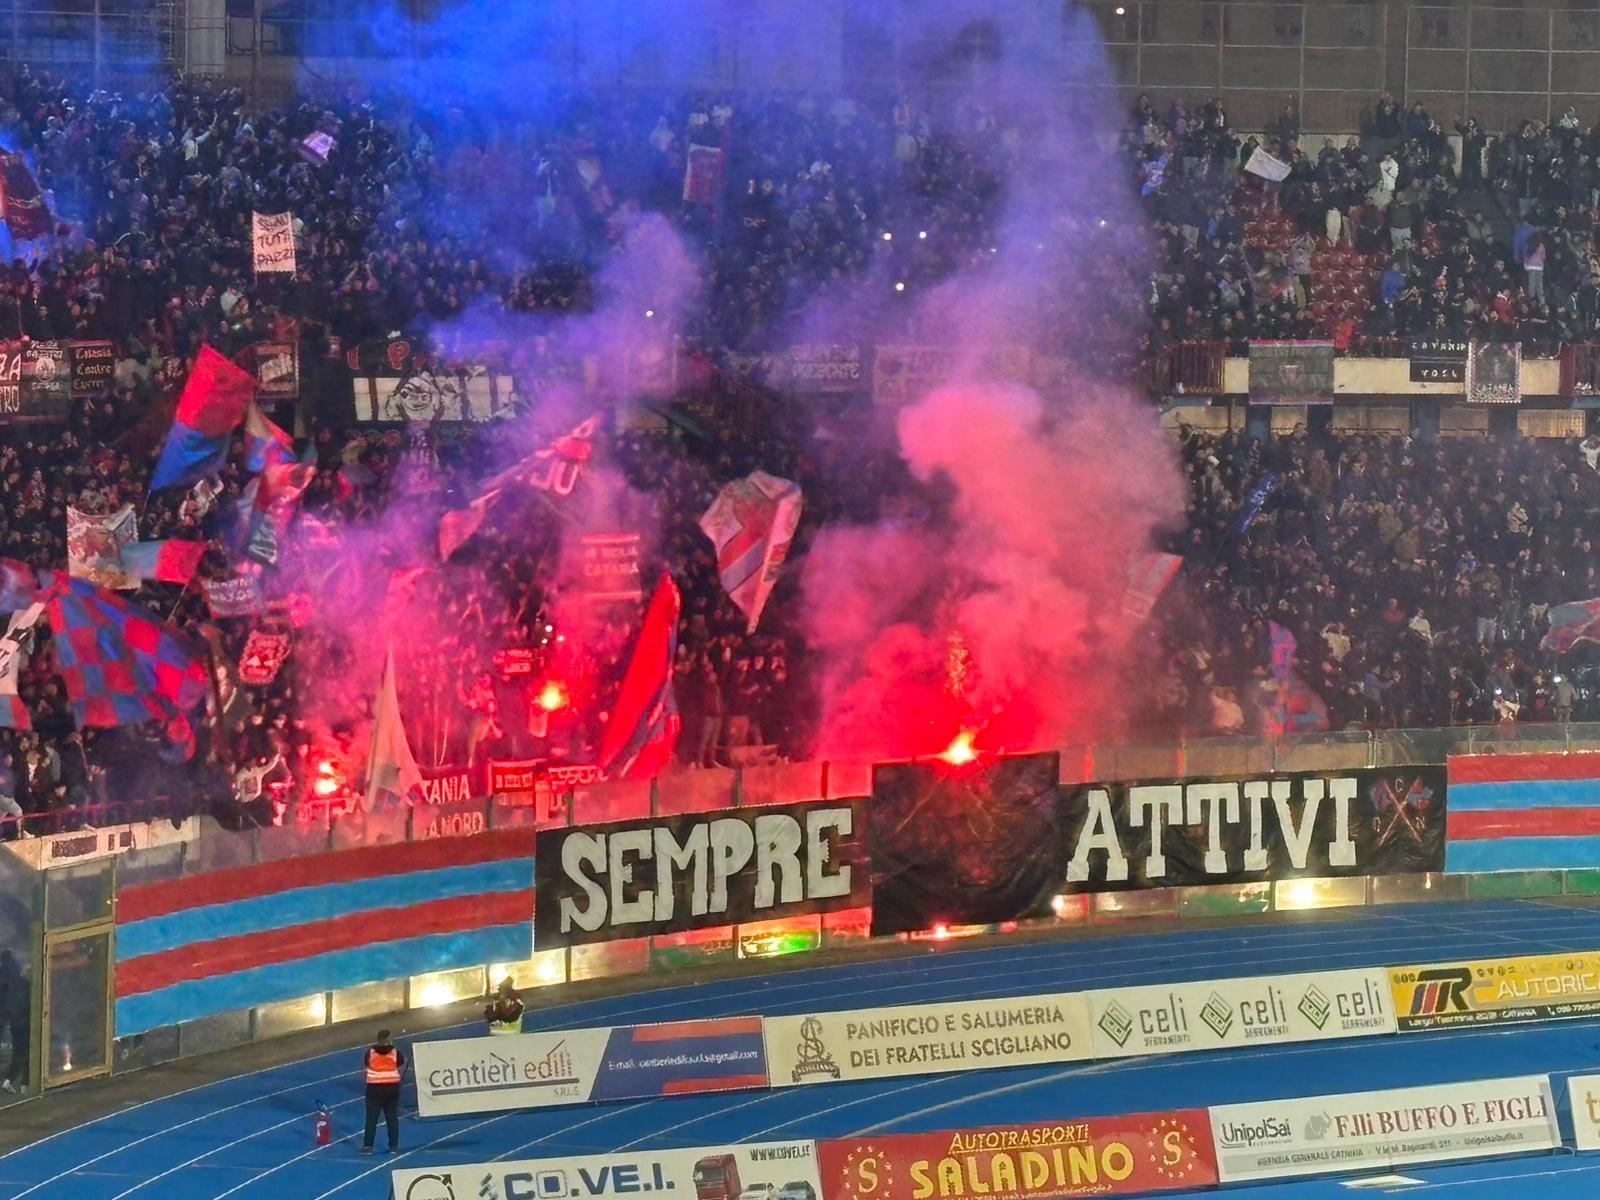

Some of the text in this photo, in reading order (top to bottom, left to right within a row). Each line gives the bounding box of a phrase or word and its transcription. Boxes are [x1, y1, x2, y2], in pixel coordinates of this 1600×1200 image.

[1066, 777, 1357, 882] ATTIVI
[560, 807, 852, 934] SEMPRE
[1139, 992, 1189, 1034] celi
[1240, 985, 1288, 1027] celi
[1336, 977, 1383, 1018] celi
[847, 1004, 1065, 1041] PANIFICIO E SALUMERIA
[850, 1030, 1072, 1069] DEI FRATELLI SCIGLIANO
[429, 1054, 518, 1089] cantieri
[1221, 1116, 1292, 1147] UnipolSai
[1334, 1094, 1548, 1139] F.lli BUFFO E FIGLI
[950, 1123, 1090, 1152] AUTOTRASPORTI
[1163, 1130, 1182, 1165] S
[858, 1157, 879, 1194] S
[910, 1142, 1134, 1200] SALADINO
